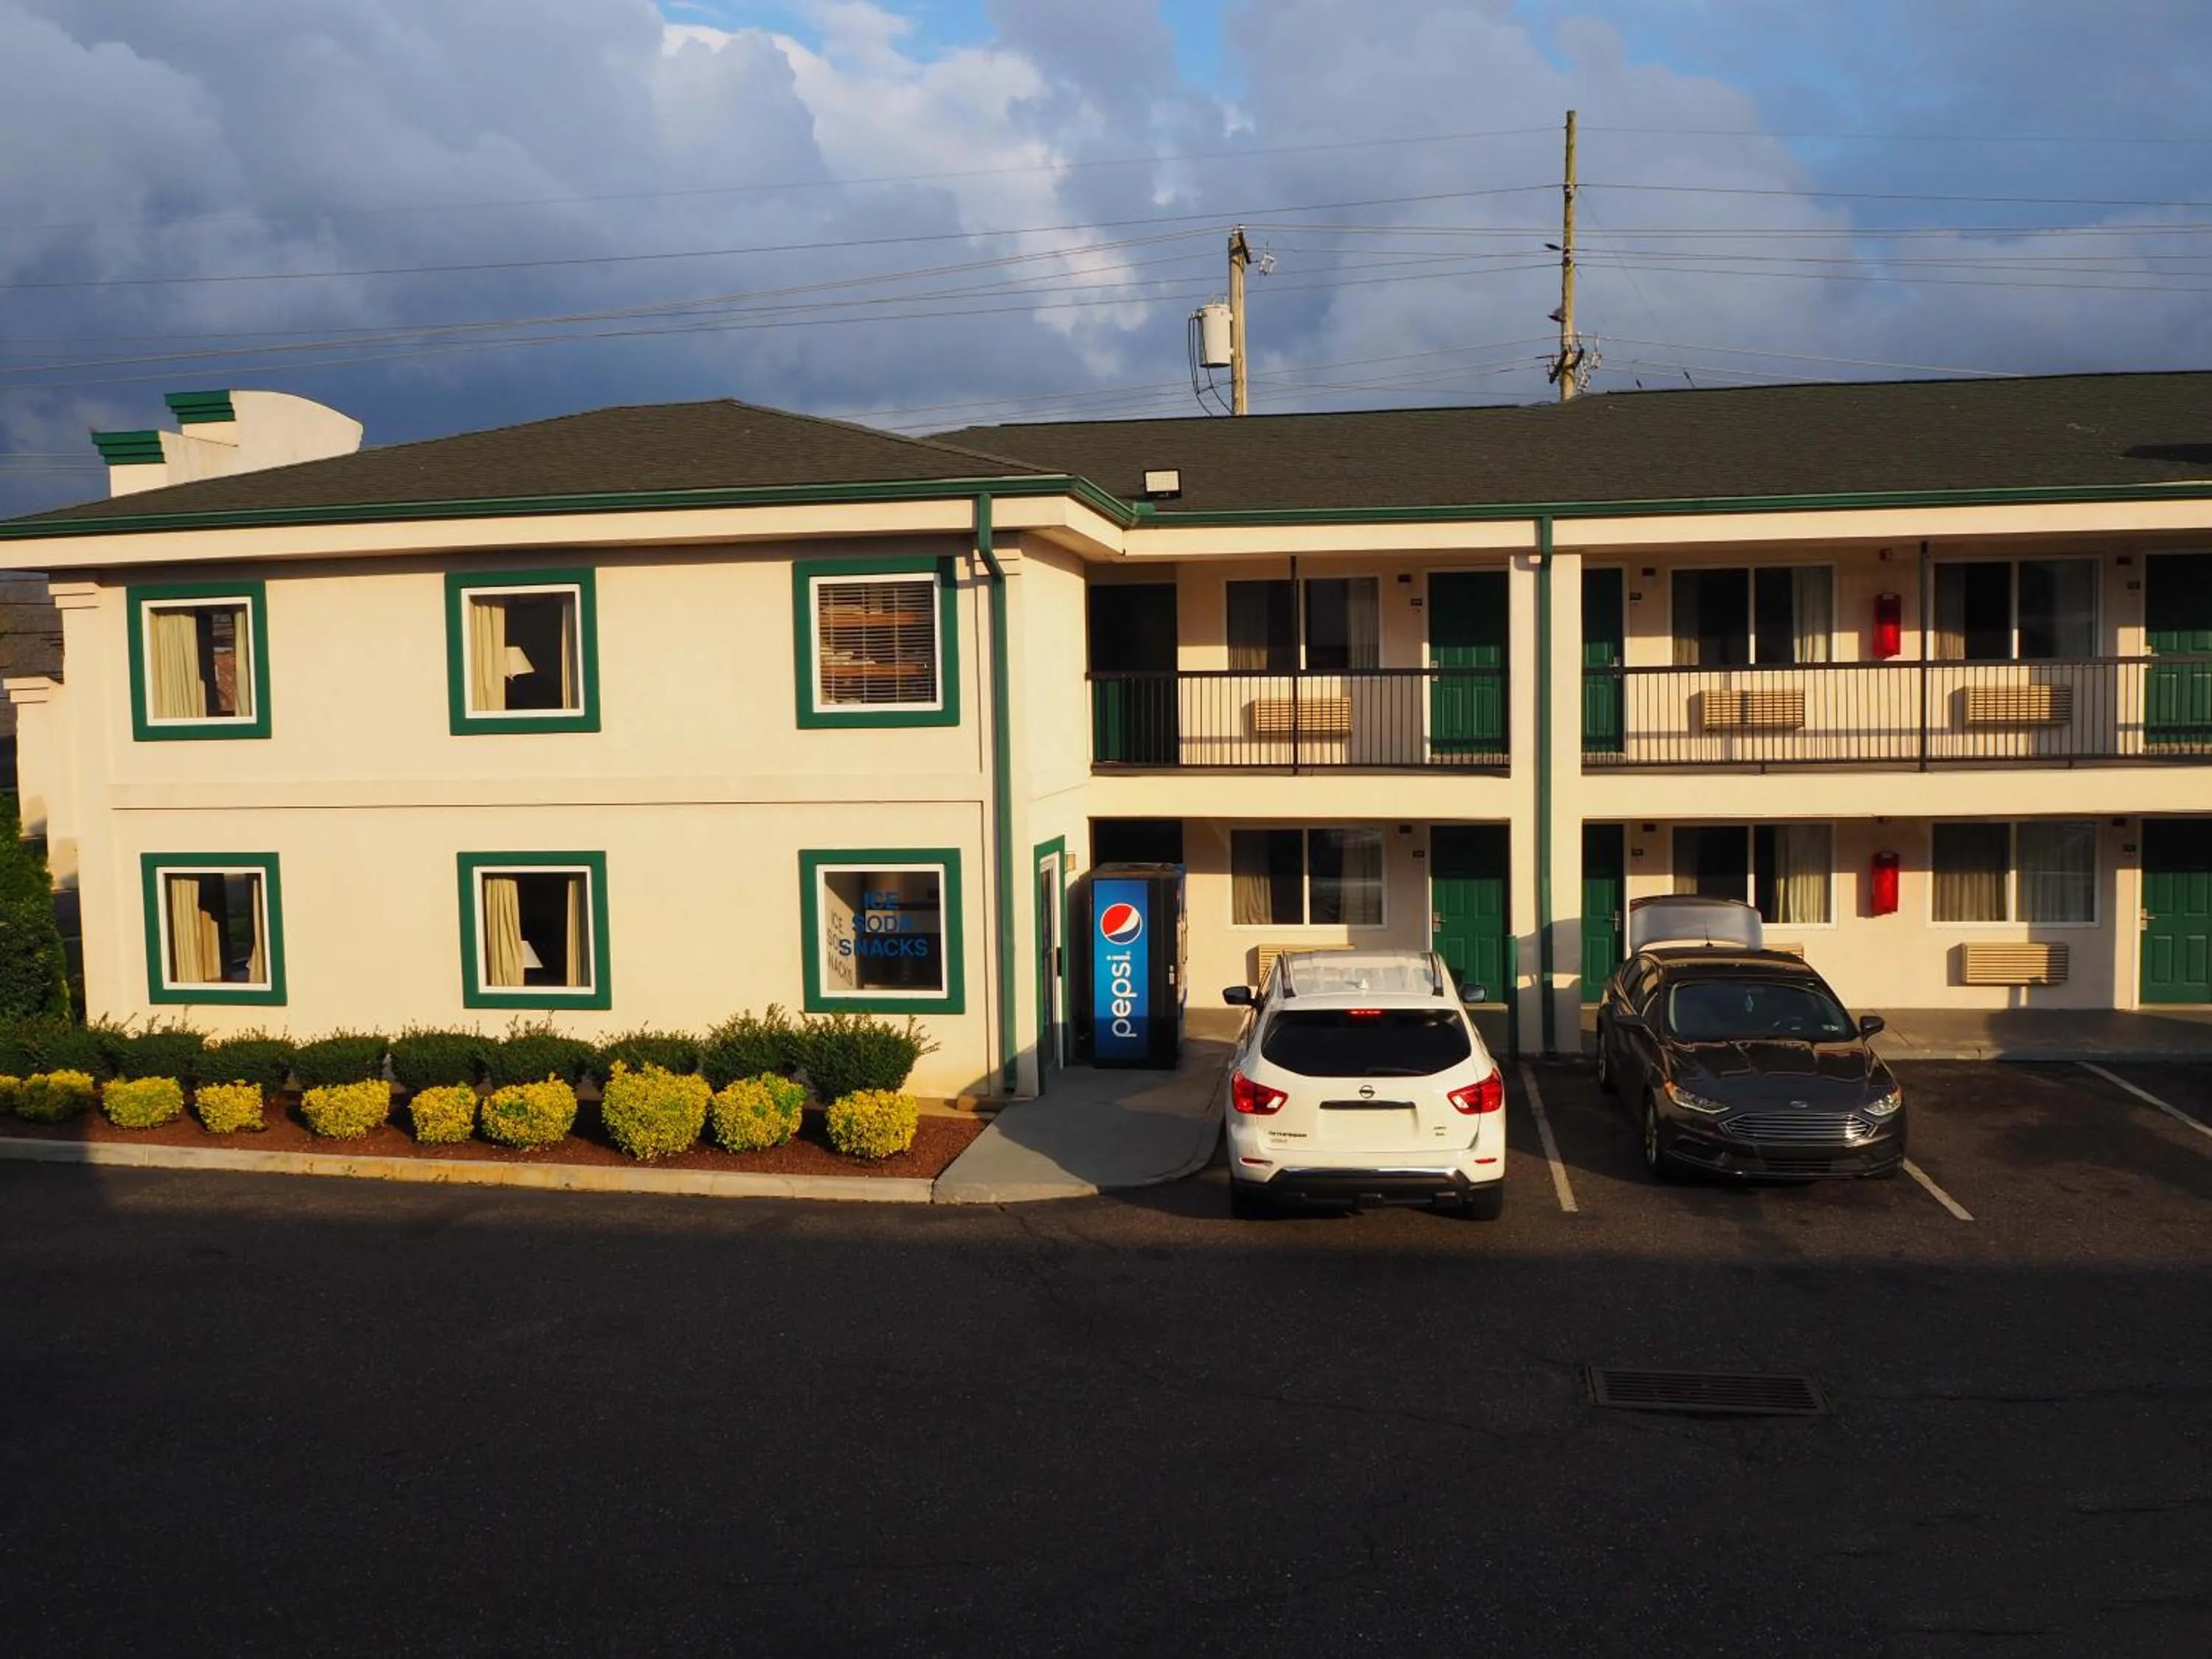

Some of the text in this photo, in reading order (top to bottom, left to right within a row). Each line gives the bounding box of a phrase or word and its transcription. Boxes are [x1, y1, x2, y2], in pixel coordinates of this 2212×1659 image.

[863, 891, 899, 910] ICE
[839, 939, 928, 956] SNACKS
[1106, 953, 1137, 1037] pepsi
